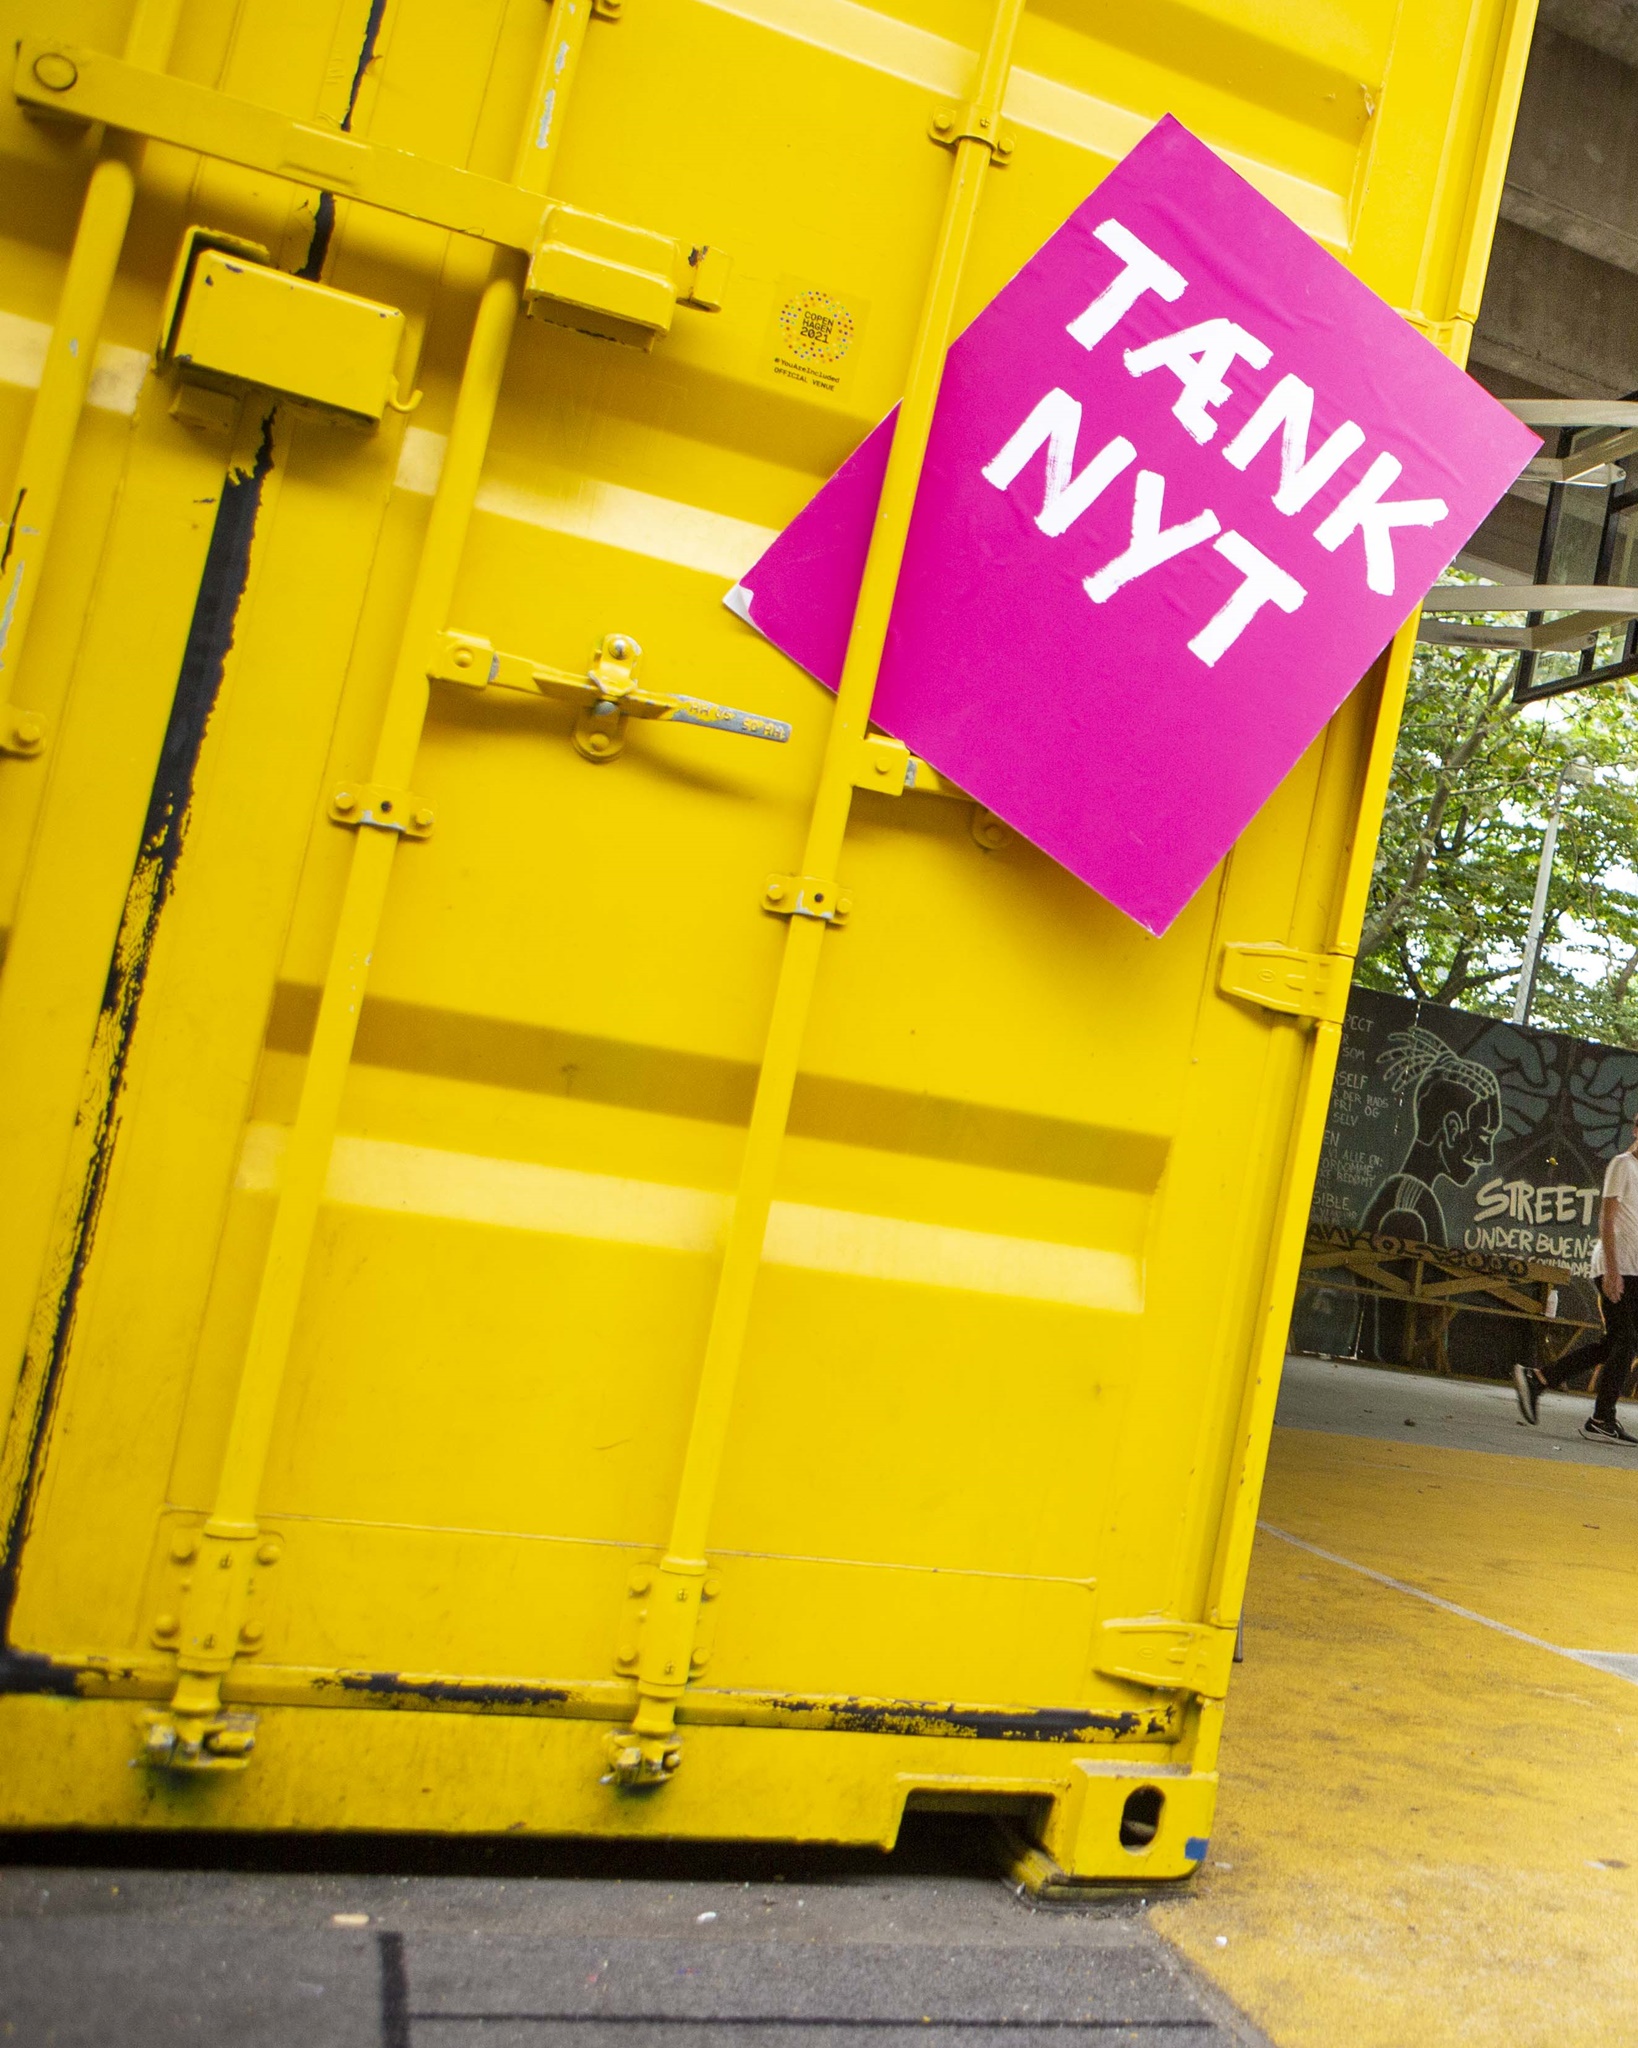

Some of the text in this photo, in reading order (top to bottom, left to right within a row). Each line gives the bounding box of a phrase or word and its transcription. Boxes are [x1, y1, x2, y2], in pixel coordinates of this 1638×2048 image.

[802, 319, 833, 334] HAGEN
[804, 311, 834, 327] COPEN
[800, 326, 829, 344] 2021
[774, 367, 835, 392] OFFICIAL VENUE
[1066, 218, 1449, 596] TÆNK
[981, 387, 1308, 668] NYT
[1364, 1105, 1380, 1118] OG
[1473, 1178, 1600, 1226] STREET
[1464, 1226, 1534, 1252] UNDER
